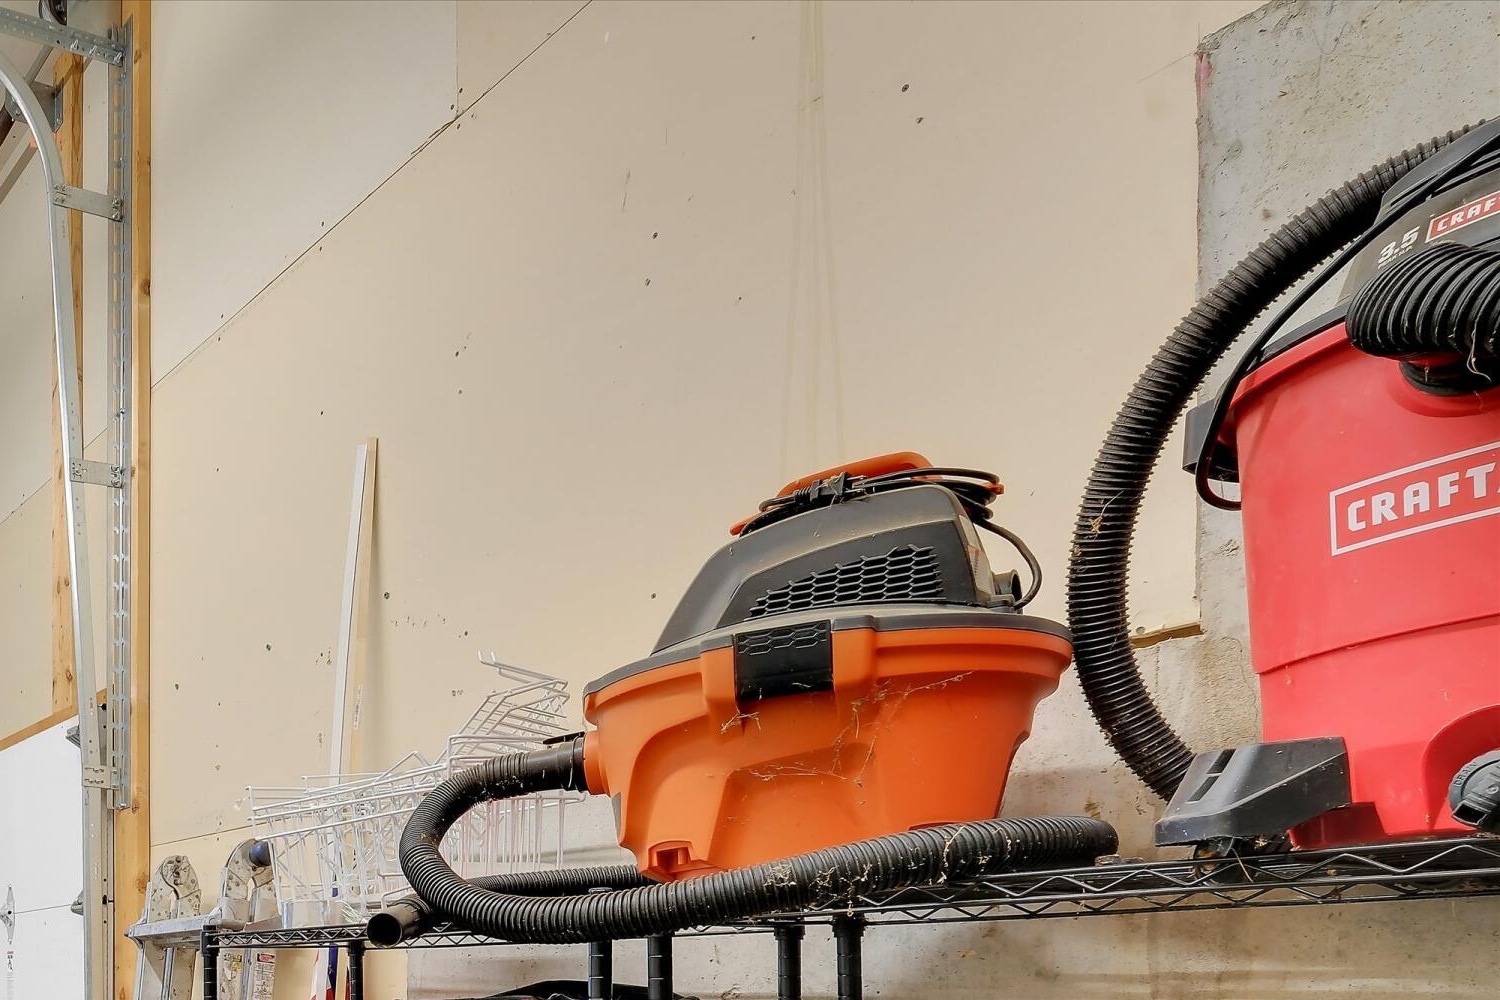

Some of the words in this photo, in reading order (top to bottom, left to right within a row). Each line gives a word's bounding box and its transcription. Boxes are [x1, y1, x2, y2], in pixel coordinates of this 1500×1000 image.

[1437, 197, 1500, 231] CRAF
[1378, 226, 1420, 263] 3.5
[1348, 462, 1500, 532] CRAFT
